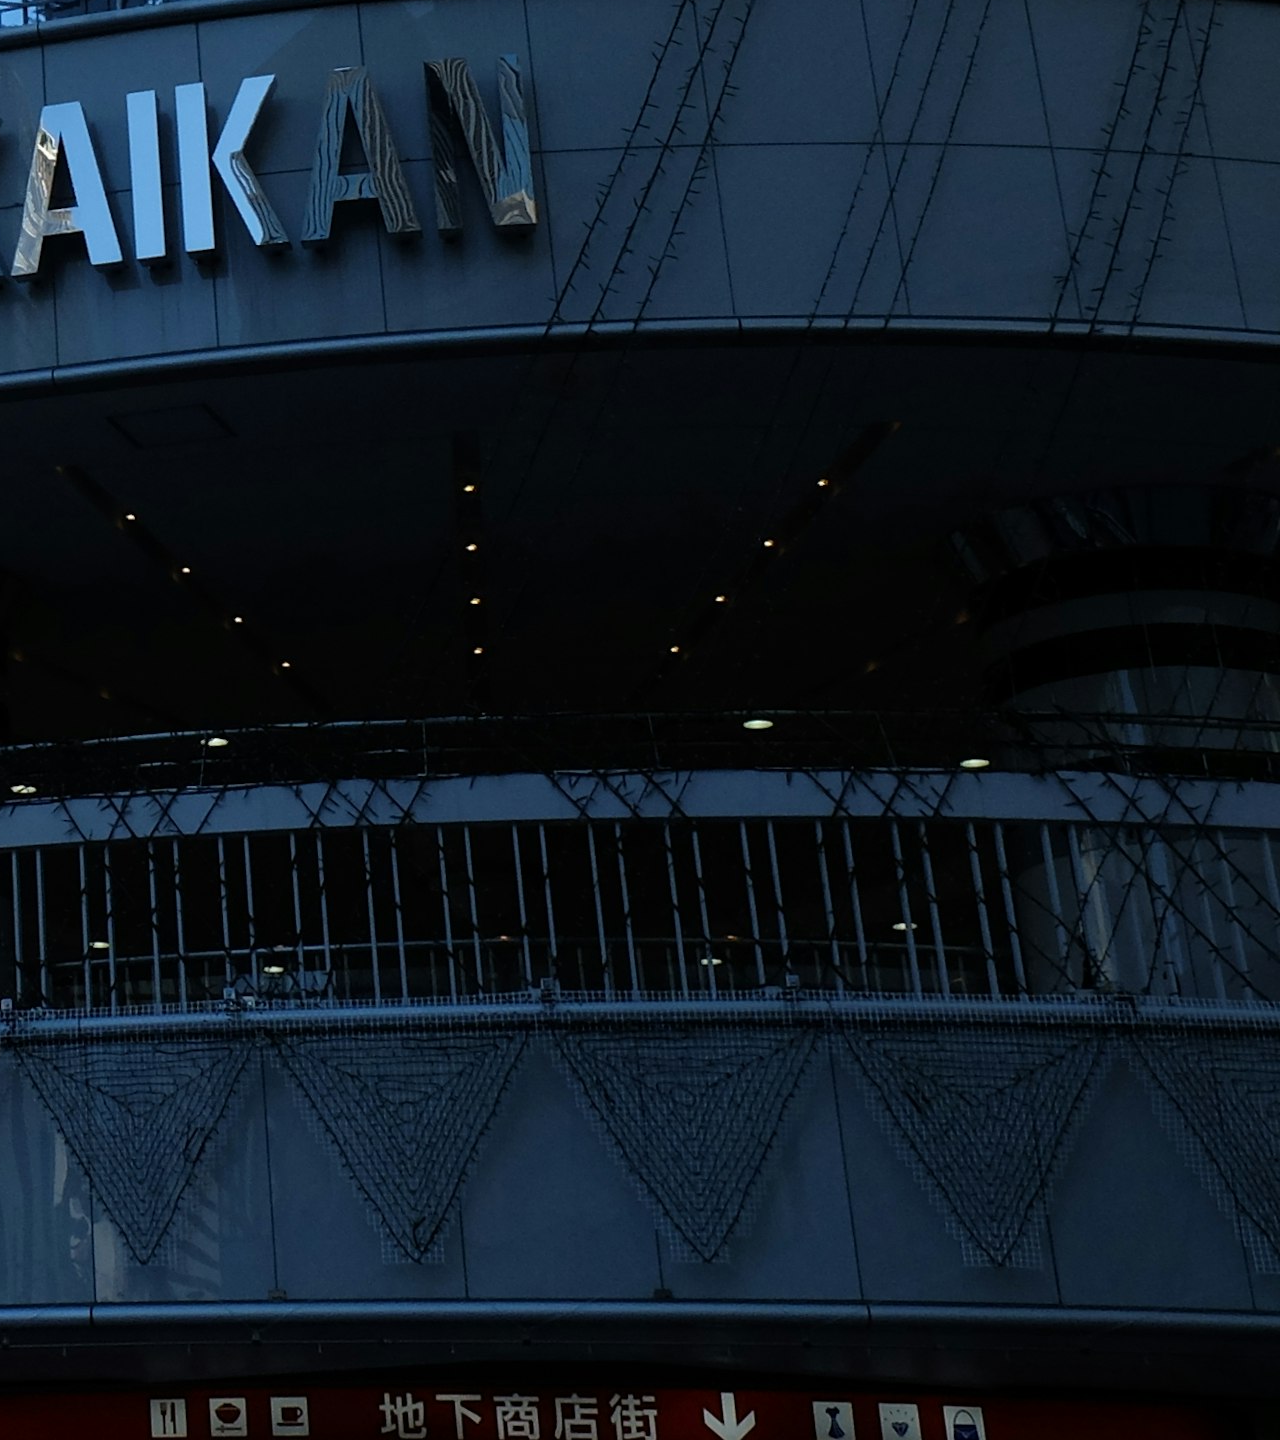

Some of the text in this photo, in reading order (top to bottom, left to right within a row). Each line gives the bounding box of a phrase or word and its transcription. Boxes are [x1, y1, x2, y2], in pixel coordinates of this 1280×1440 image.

[378, 1392, 658, 1440] 地下商店街
